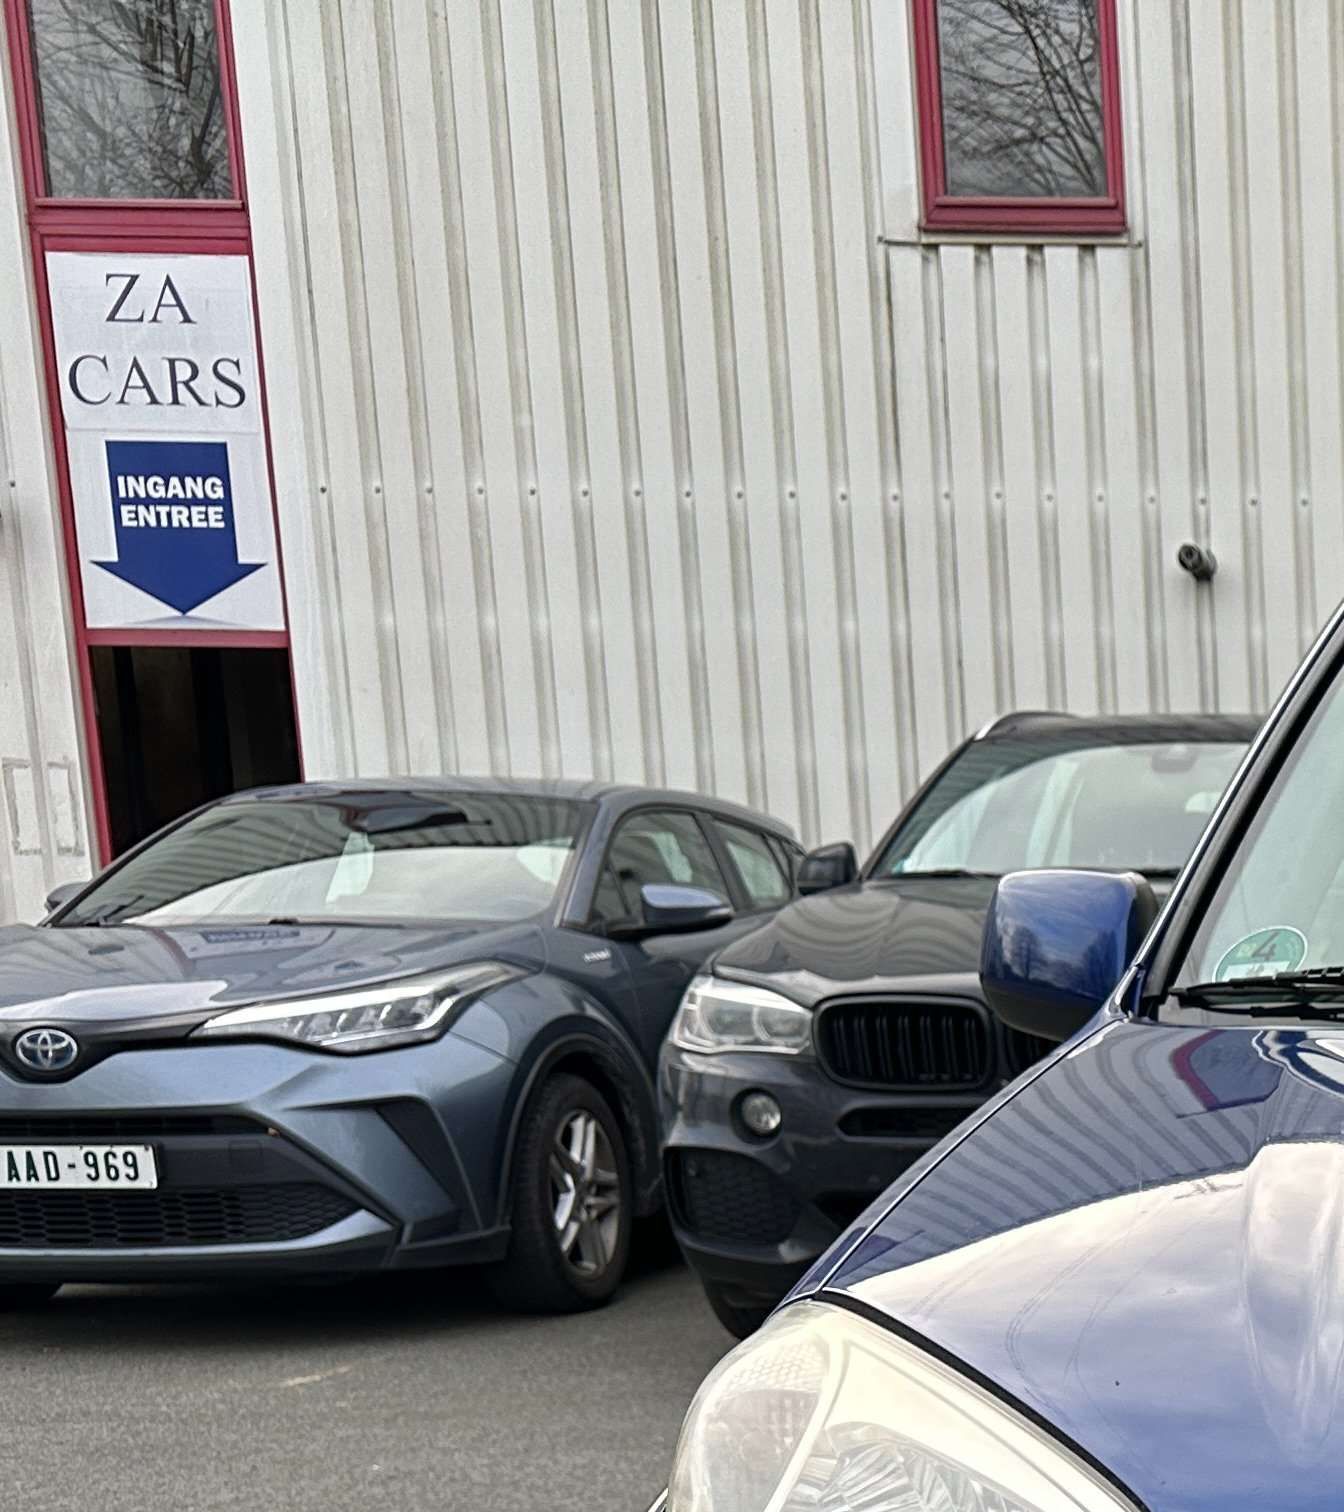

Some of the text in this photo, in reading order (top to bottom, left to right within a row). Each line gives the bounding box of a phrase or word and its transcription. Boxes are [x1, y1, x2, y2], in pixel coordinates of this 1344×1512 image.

[104, 273, 198, 325] ZA
[67, 354, 247, 409] CARS
[116, 475, 225, 500] INGANG
[120, 504, 226, 529] ENTREE
